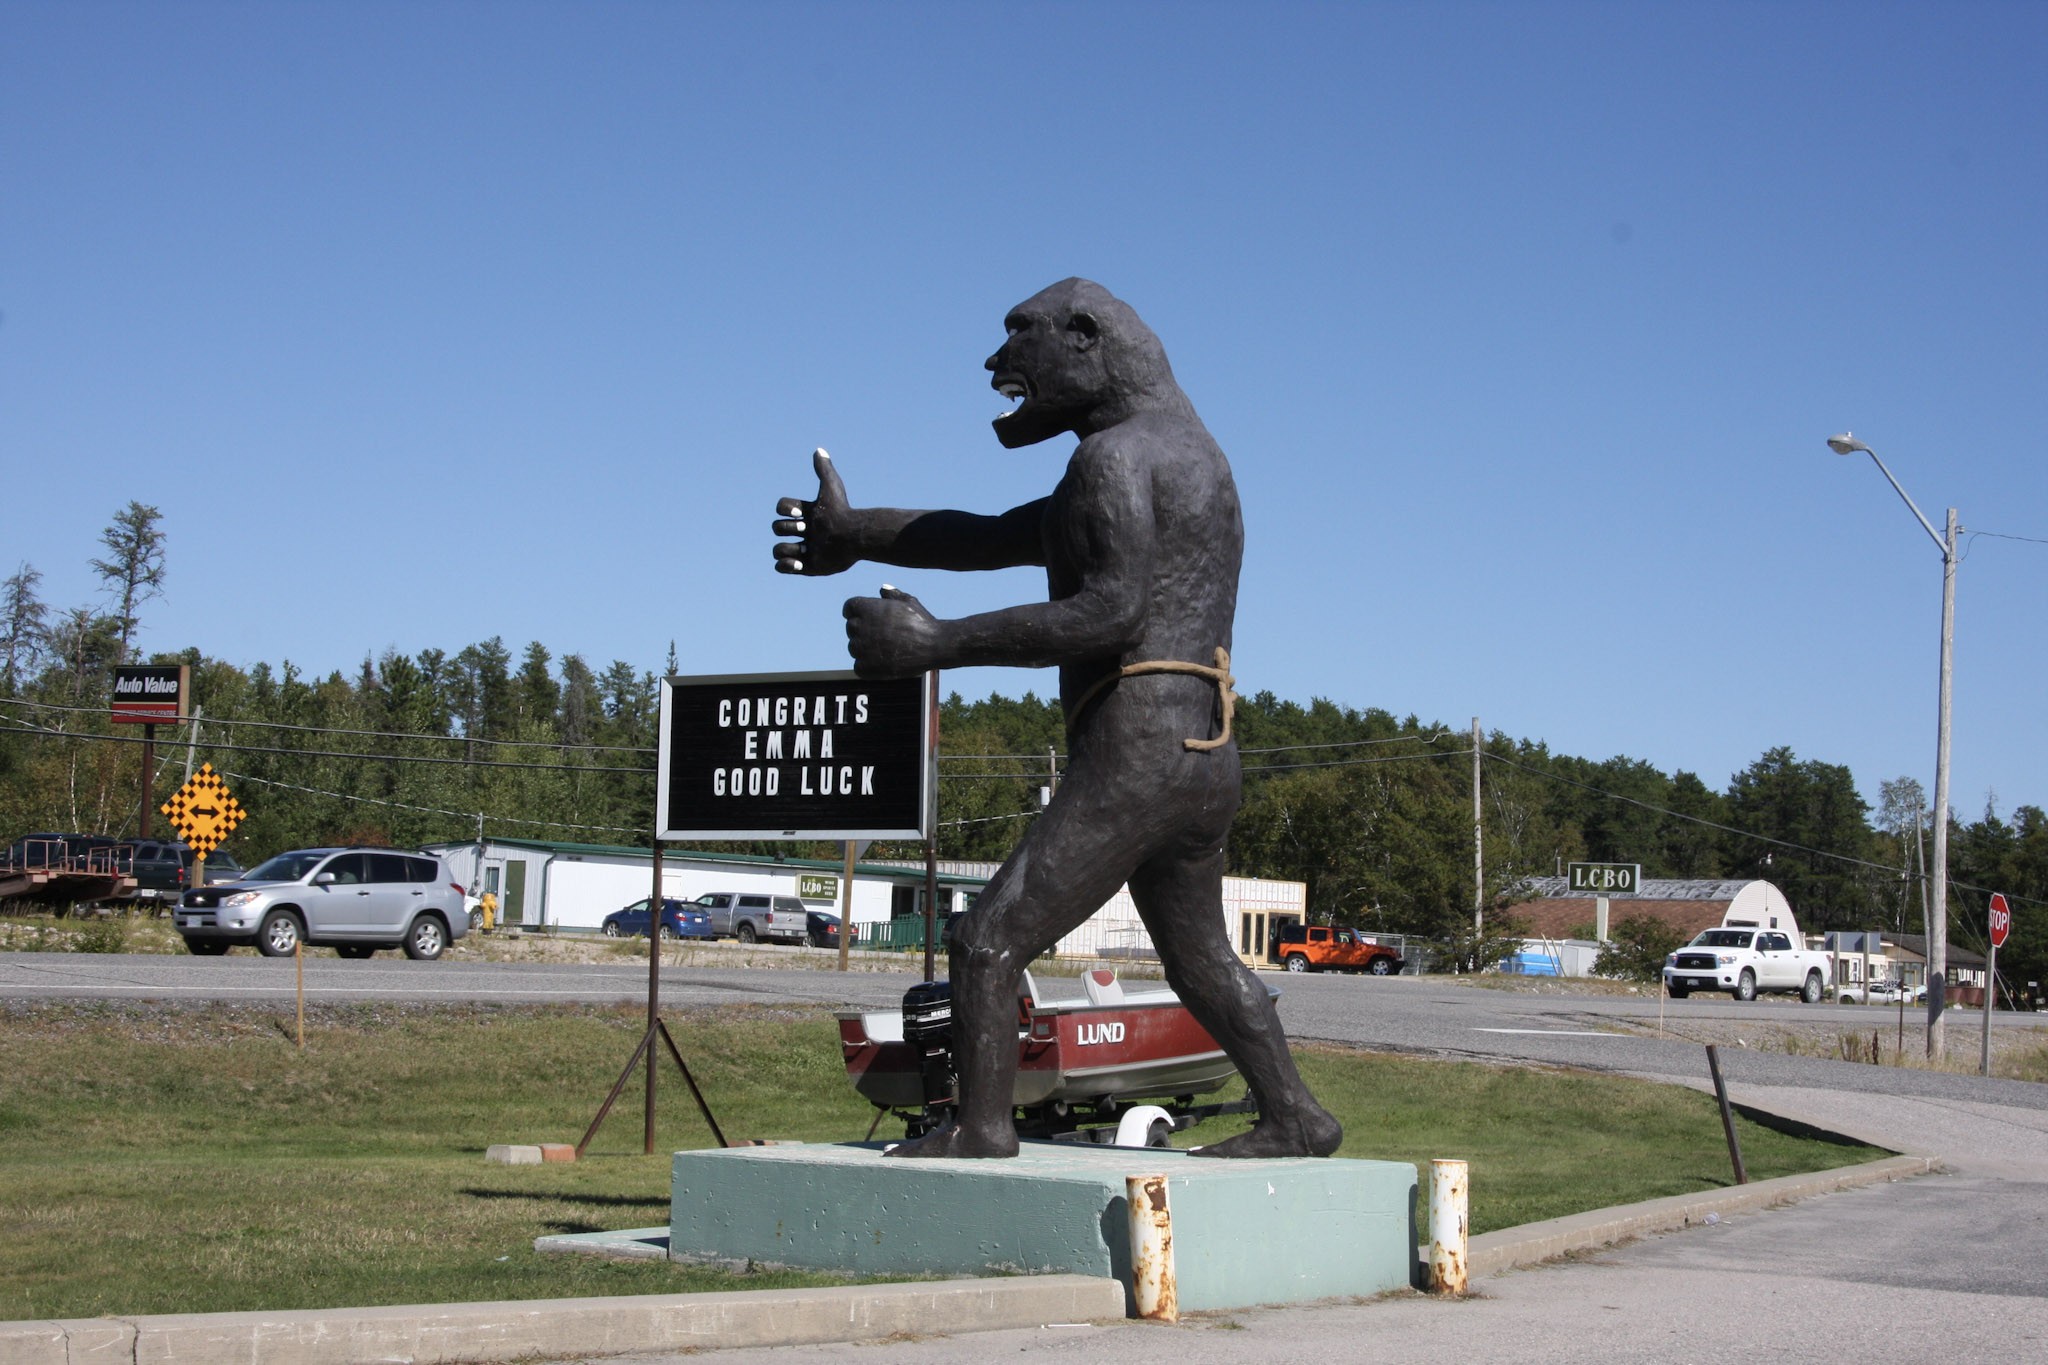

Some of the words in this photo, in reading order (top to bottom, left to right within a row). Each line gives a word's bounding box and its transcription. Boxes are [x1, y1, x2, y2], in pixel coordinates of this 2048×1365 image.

[114, 676, 143, 694] Auto
[144, 676, 178, 694] Value
[718, 694, 869, 728] CONGRATS
[744, 729, 834, 760] EMMA
[713, 766, 780, 797] GOOD
[800, 765, 875, 796] LUCK
[802, 881, 822, 893] LCBO
[1575, 867, 1631, 889] LCBO
[1989, 908, 2008, 931] STOP
[1077, 1022, 1126, 1046] LUND
